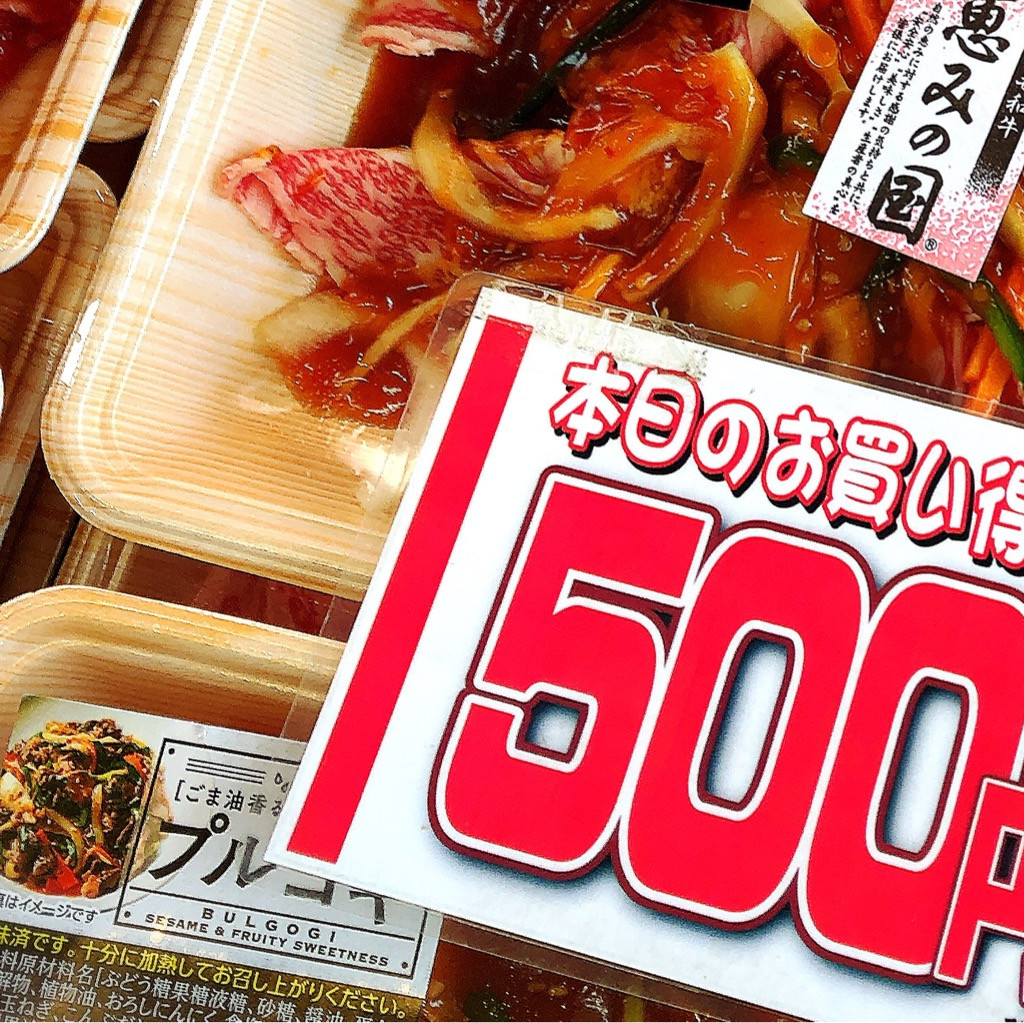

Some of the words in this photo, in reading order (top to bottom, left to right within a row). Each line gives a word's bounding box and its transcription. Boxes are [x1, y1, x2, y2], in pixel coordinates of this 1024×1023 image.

[145, 913, 209, 934] SESAME
[213, 926, 225, 937] &
[231, 929, 287, 948] FRUITY
[292, 941, 389, 967] SWEETNESS
[202, 907, 336, 943] BULGOGI
